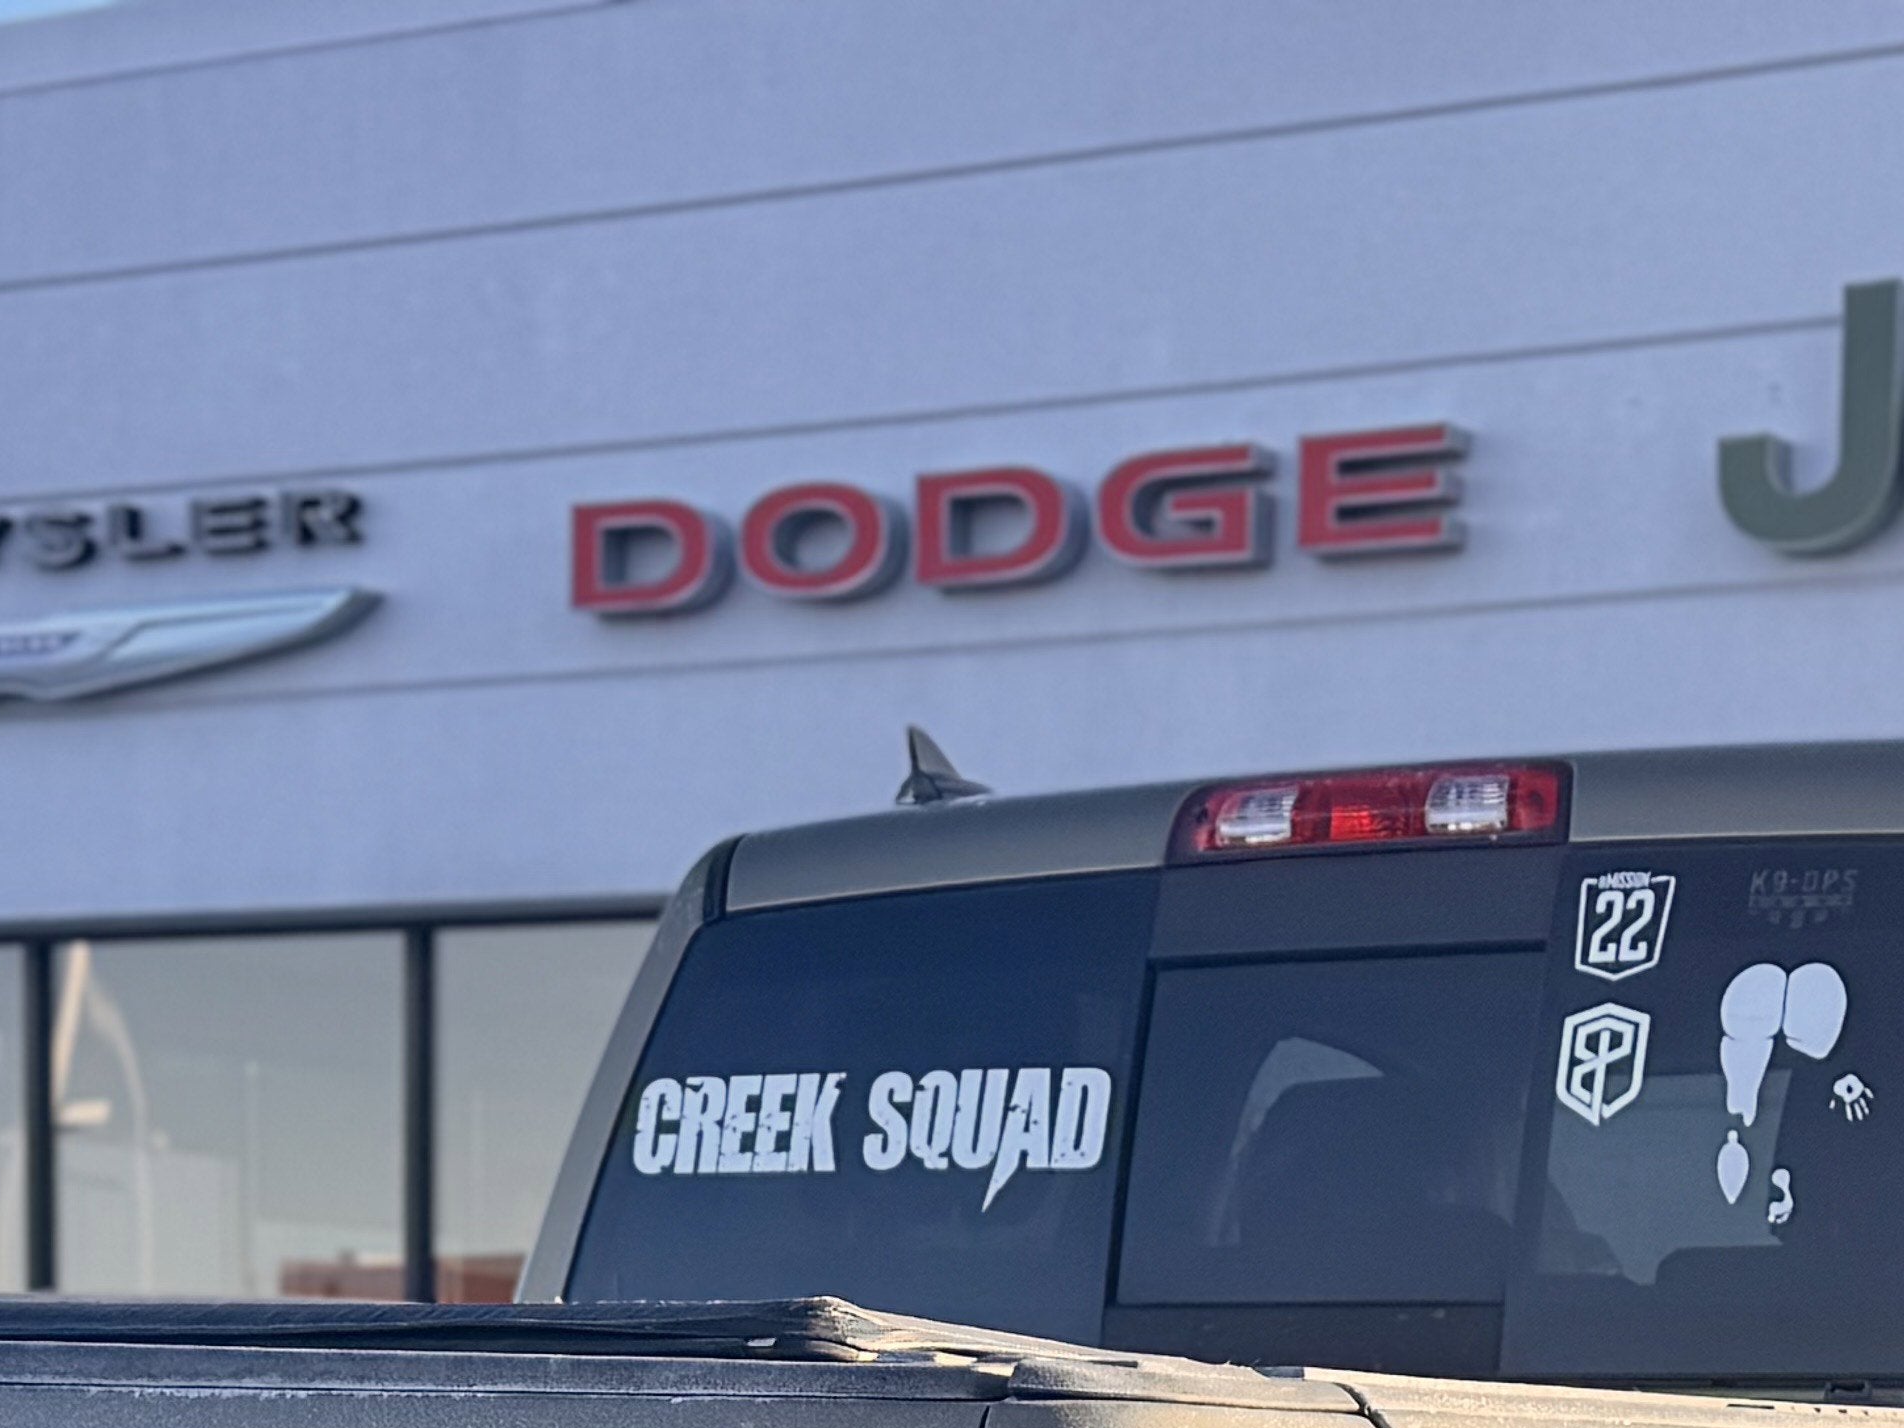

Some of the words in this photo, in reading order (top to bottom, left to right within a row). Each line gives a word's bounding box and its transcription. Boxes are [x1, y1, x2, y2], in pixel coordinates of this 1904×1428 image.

[569, 420, 1470, 619] DODGE
[1587, 888, 1656, 964] 22
[632, 1071, 848, 1175] CREEK
[861, 1066, 1113, 1213] SQUAD
